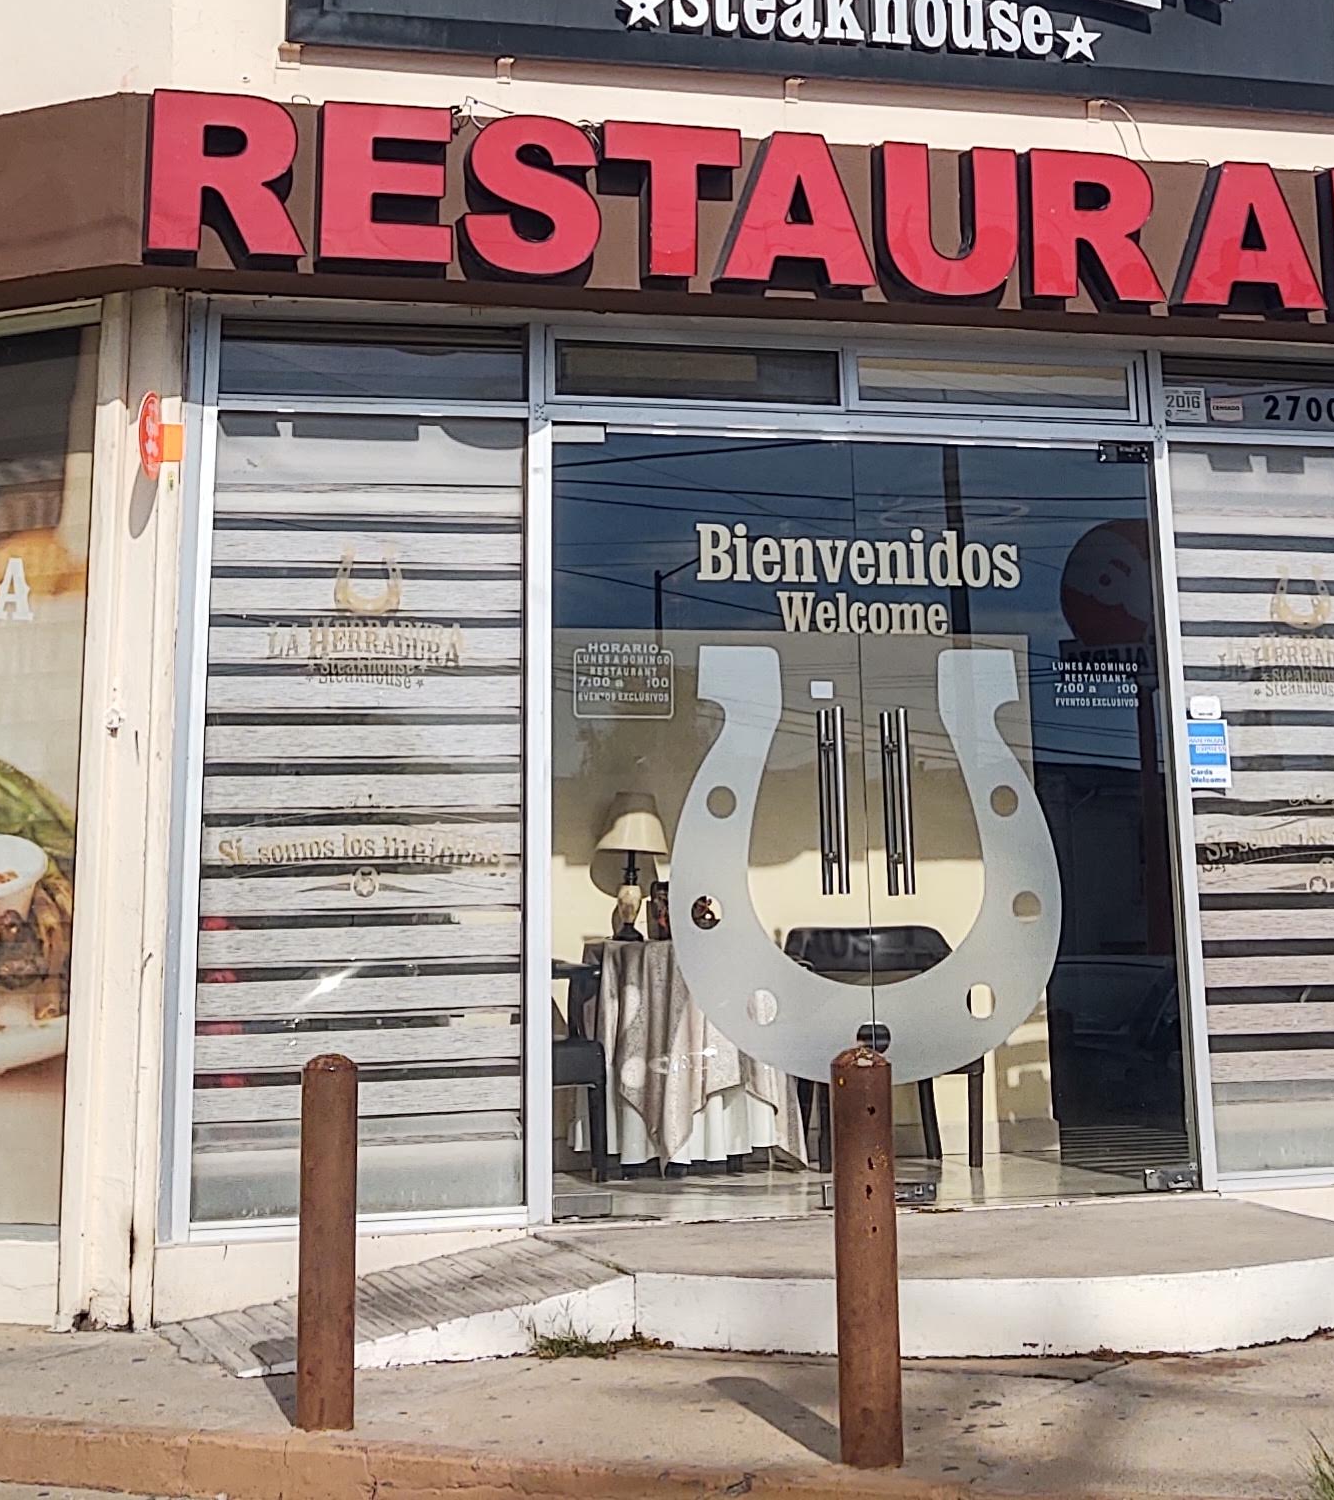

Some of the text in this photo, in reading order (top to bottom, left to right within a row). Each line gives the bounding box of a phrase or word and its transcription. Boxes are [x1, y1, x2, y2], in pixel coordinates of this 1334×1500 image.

[1166, 394, 1200, 409] 2016
[696, 523, 1021, 589] Bienvenidos
[777, 590, 949, 636] Welcome
[588, 643, 659, 654] HORARIO
[577, 654, 670, 665] LUNES A DOMINGO
[589, 666, 657, 677] RESTAURANT
[1052, 661, 1138, 672] LUNES A DOMINGO
[578, 676, 610, 687] 7:00
[1065, 674, 1127, 683] RESTAURANT
[1054, 683, 1085, 693] 7:00
[618, 692, 669, 703] EXCLUSIVOS
[1092, 698, 1139, 707] EXCLUSIVOS
[1190, 768, 1213, 776] Cards
[341, 833, 375, 858] los
